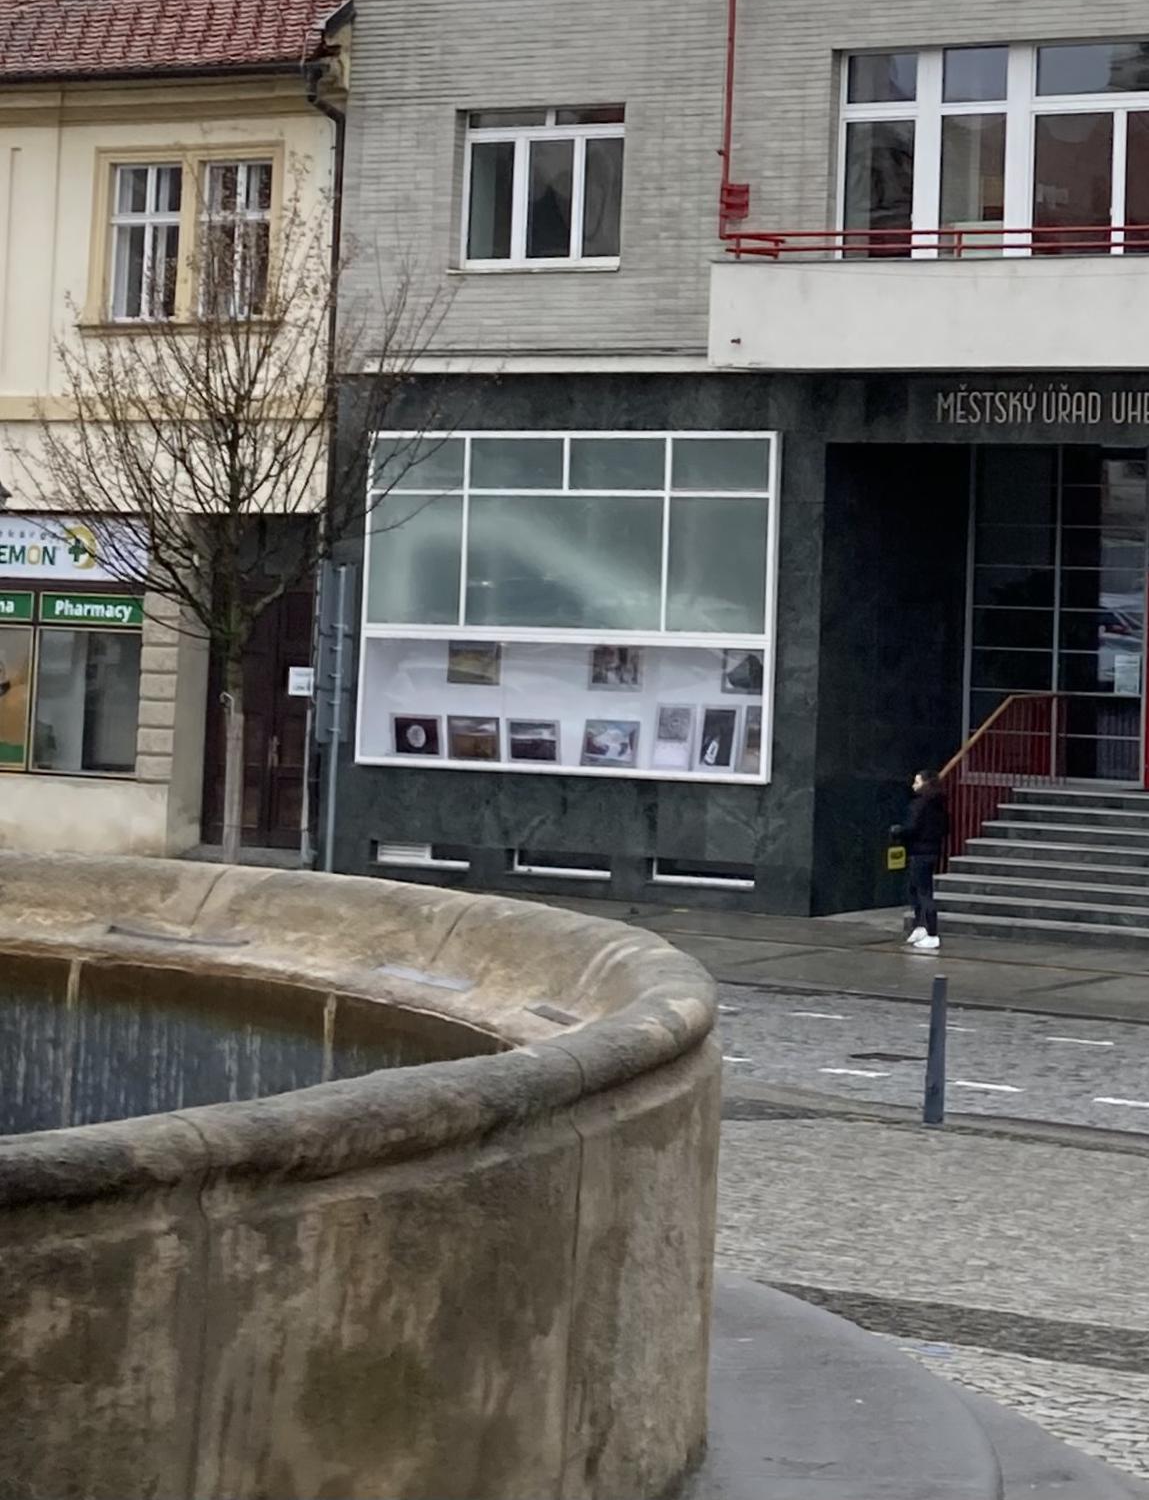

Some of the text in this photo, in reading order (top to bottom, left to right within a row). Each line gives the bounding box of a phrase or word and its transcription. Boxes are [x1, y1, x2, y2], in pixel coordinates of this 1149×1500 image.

[936, 383, 1037, 424] MĚSTSKÝ
[1042, 383, 1101, 424] ÚŘAD
[54, 599, 133, 623] Pharmacy
